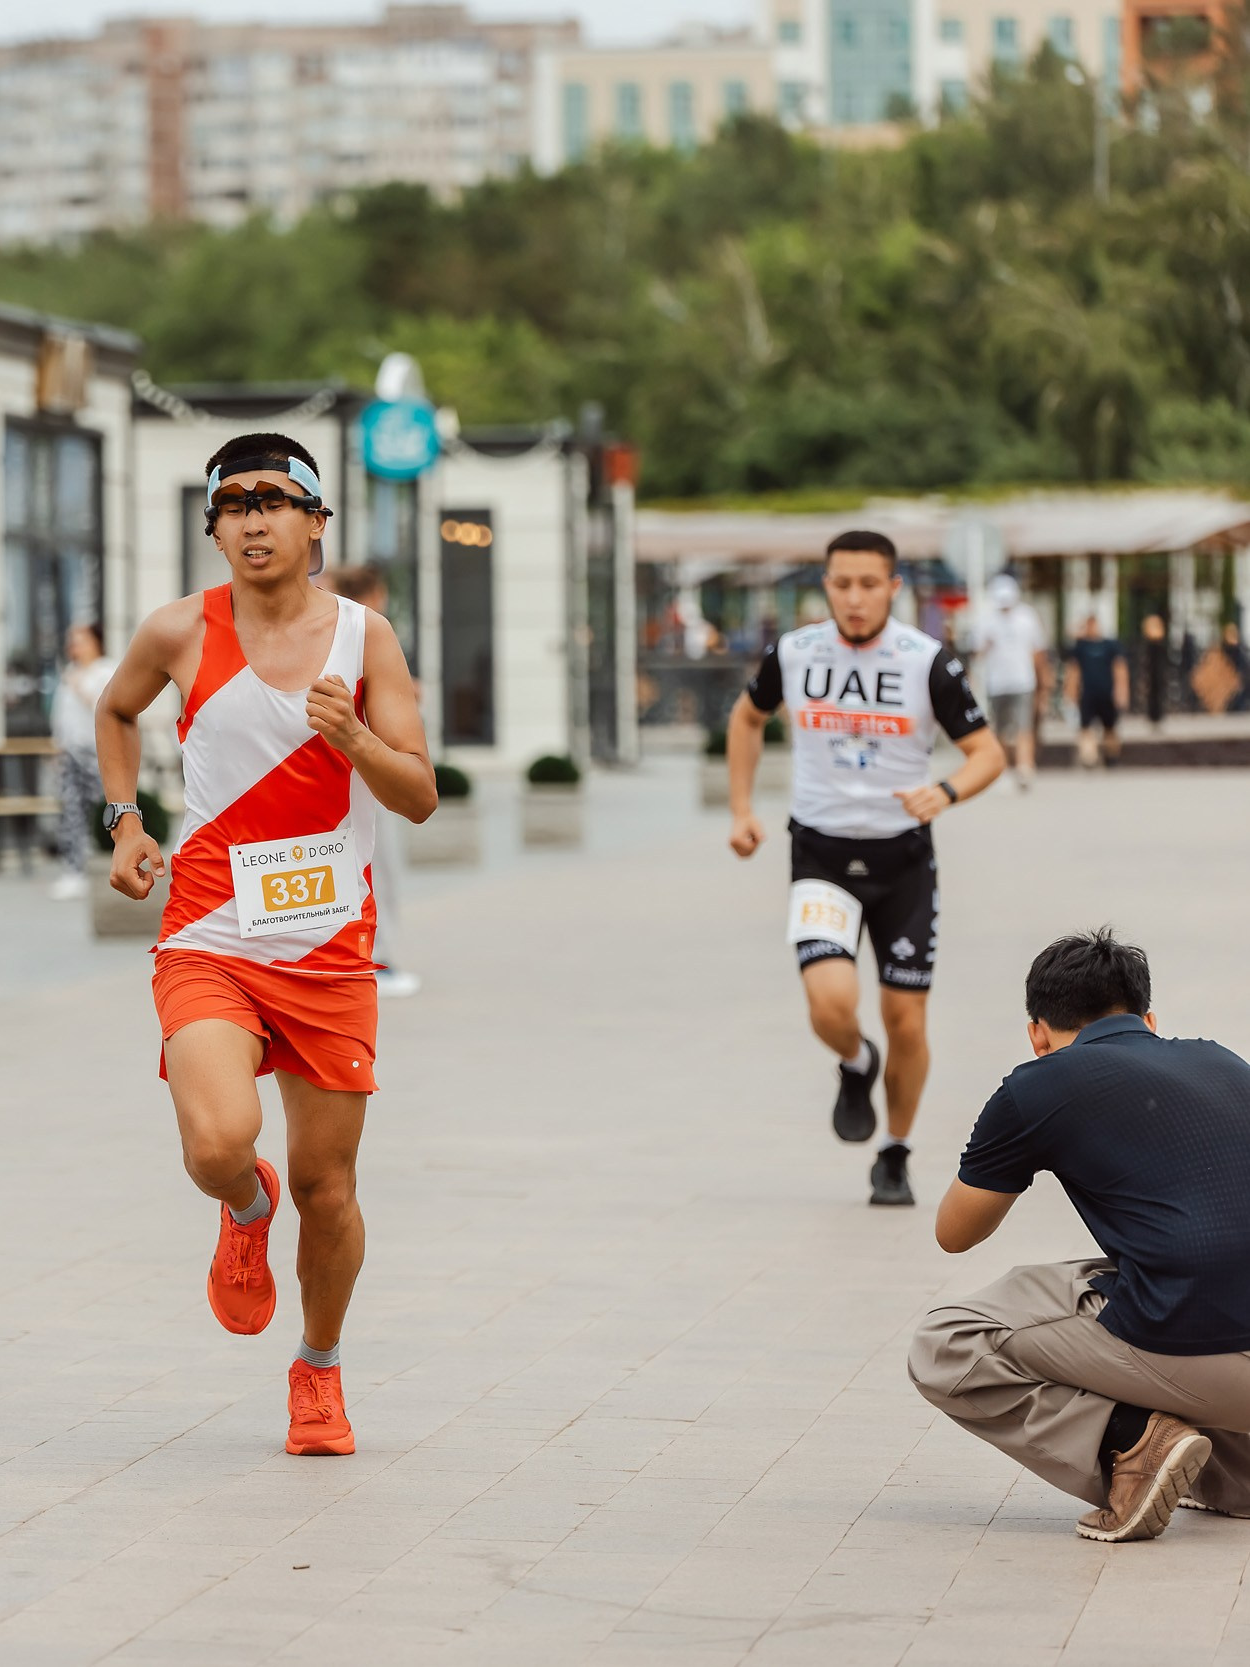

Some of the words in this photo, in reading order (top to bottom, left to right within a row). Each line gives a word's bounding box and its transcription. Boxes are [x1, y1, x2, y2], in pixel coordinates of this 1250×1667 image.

[804, 667, 903, 705] UAE
[241, 851, 287, 868] LEONE
[308, 842, 344, 858] D'ORO
[269, 871, 326, 906] 337
[251, 907, 331, 927] БЛАГОТВОРИТЕЛЬНЫЙ
[331, 905, 350, 915] ЗАБЕГ
